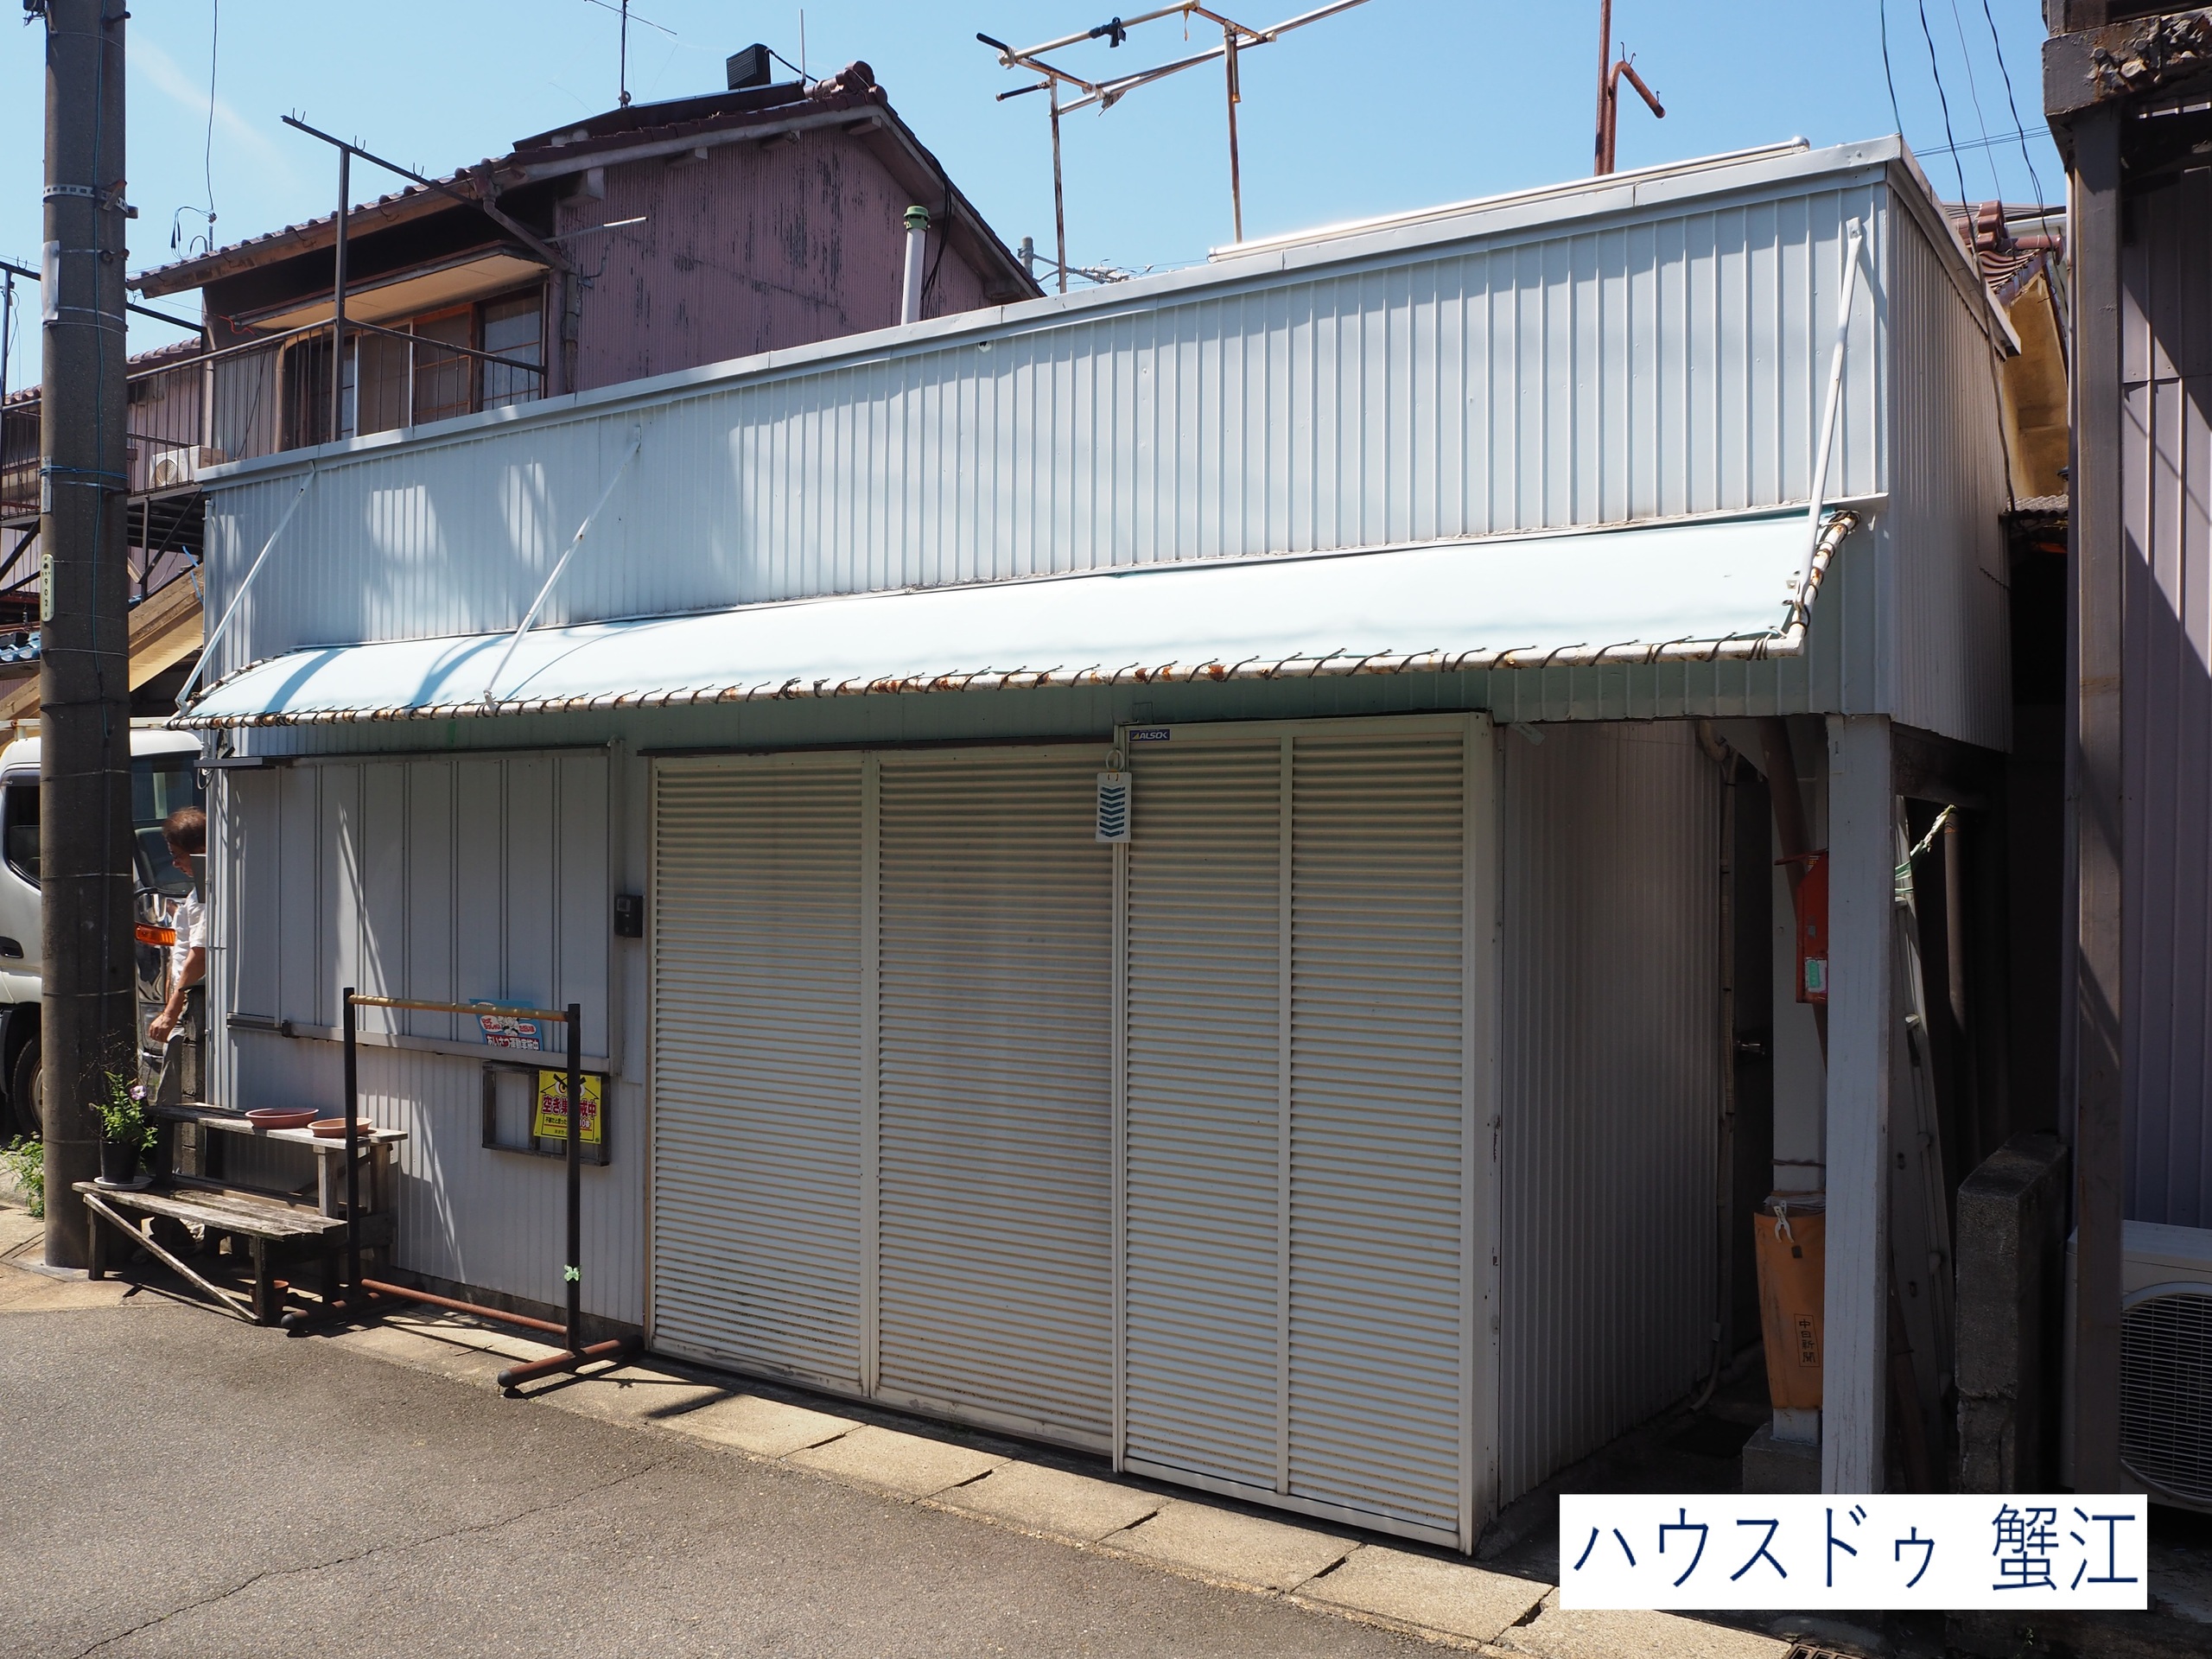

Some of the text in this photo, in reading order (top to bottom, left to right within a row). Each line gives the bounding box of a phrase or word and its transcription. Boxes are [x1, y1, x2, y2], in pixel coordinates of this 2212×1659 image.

[543, 1096, 596, 1118] 空き巣戒中
[1799, 1319, 1816, 1363] 中日新聞
